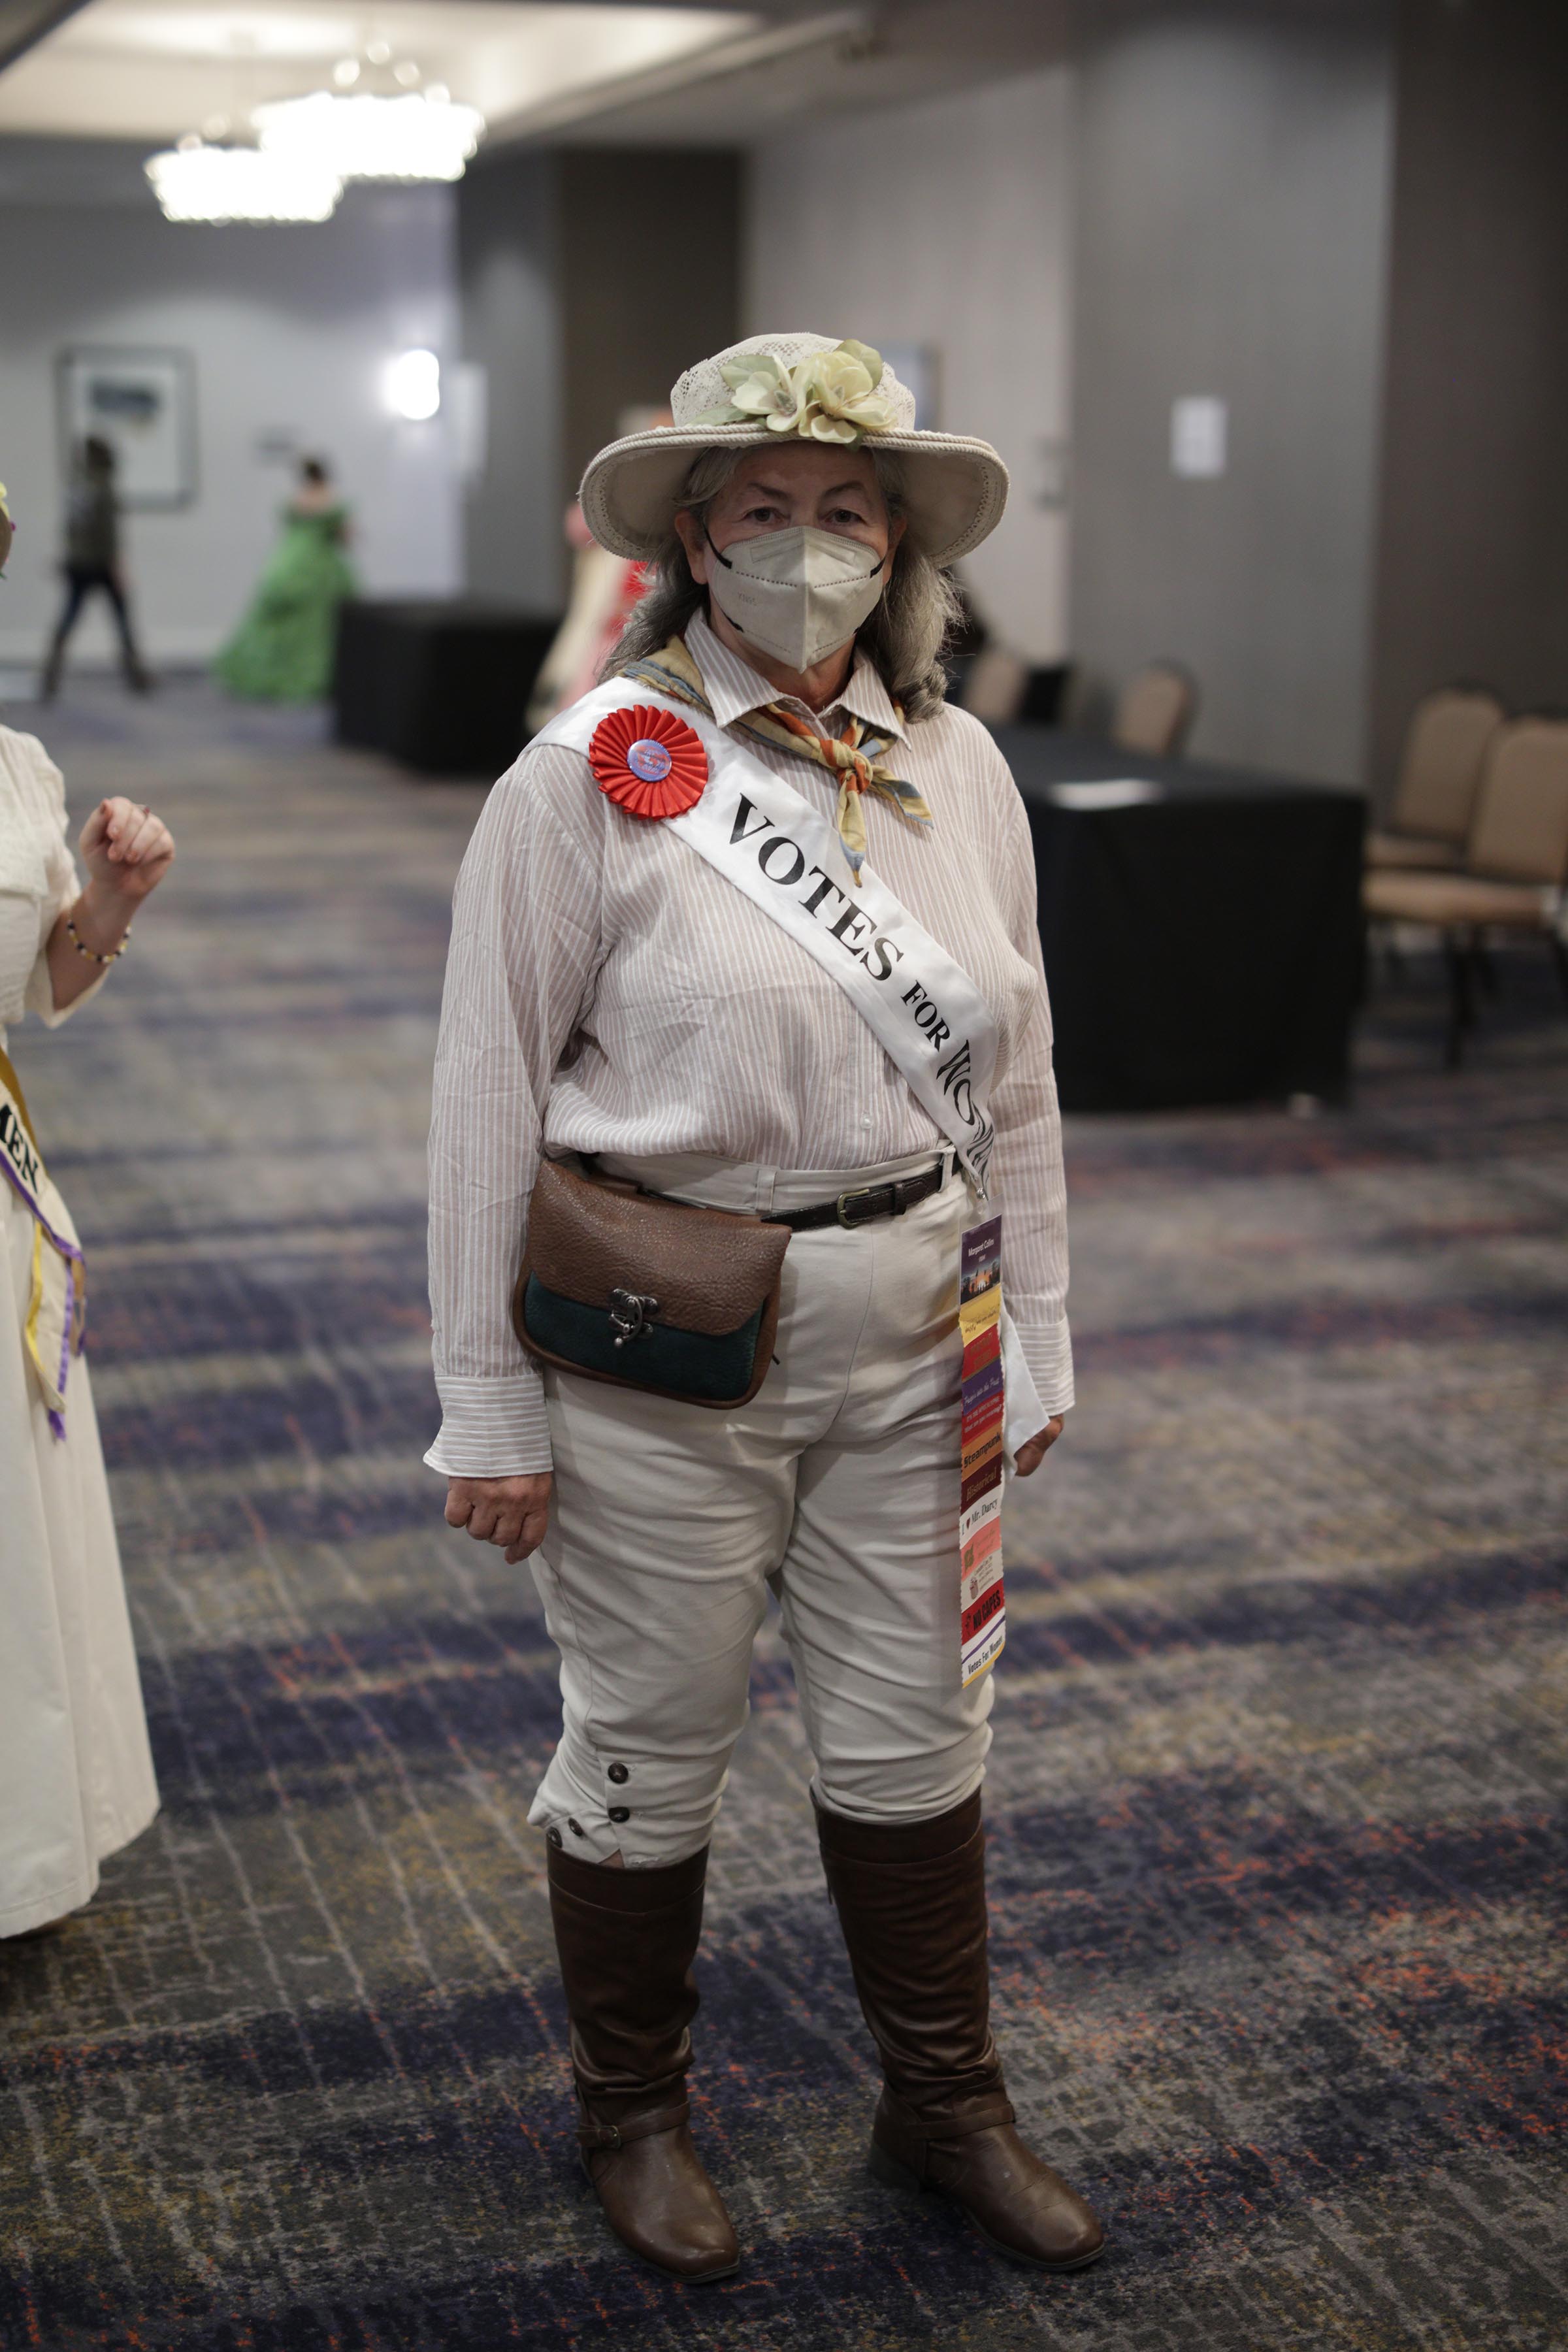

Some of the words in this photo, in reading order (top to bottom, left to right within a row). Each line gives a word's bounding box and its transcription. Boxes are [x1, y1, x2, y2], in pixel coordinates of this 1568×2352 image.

[729, 793, 904, 981] VOTES
[901, 980, 951, 1051] FOR
[968, 1243, 984, 1257] Margaret
[964, 1433, 1002, 1468] Steampunk
[967, 1465, 997, 1501] Historical
[962, 1523, 965, 1535] I
[972, 1511, 981, 1524] Mr.
[981, 1499, 998, 1516] Darcy
[973, 1608, 982, 1631] NO
[982, 1590, 1001, 1621] CAPES
[968, 1659, 981, 1674] Votes
